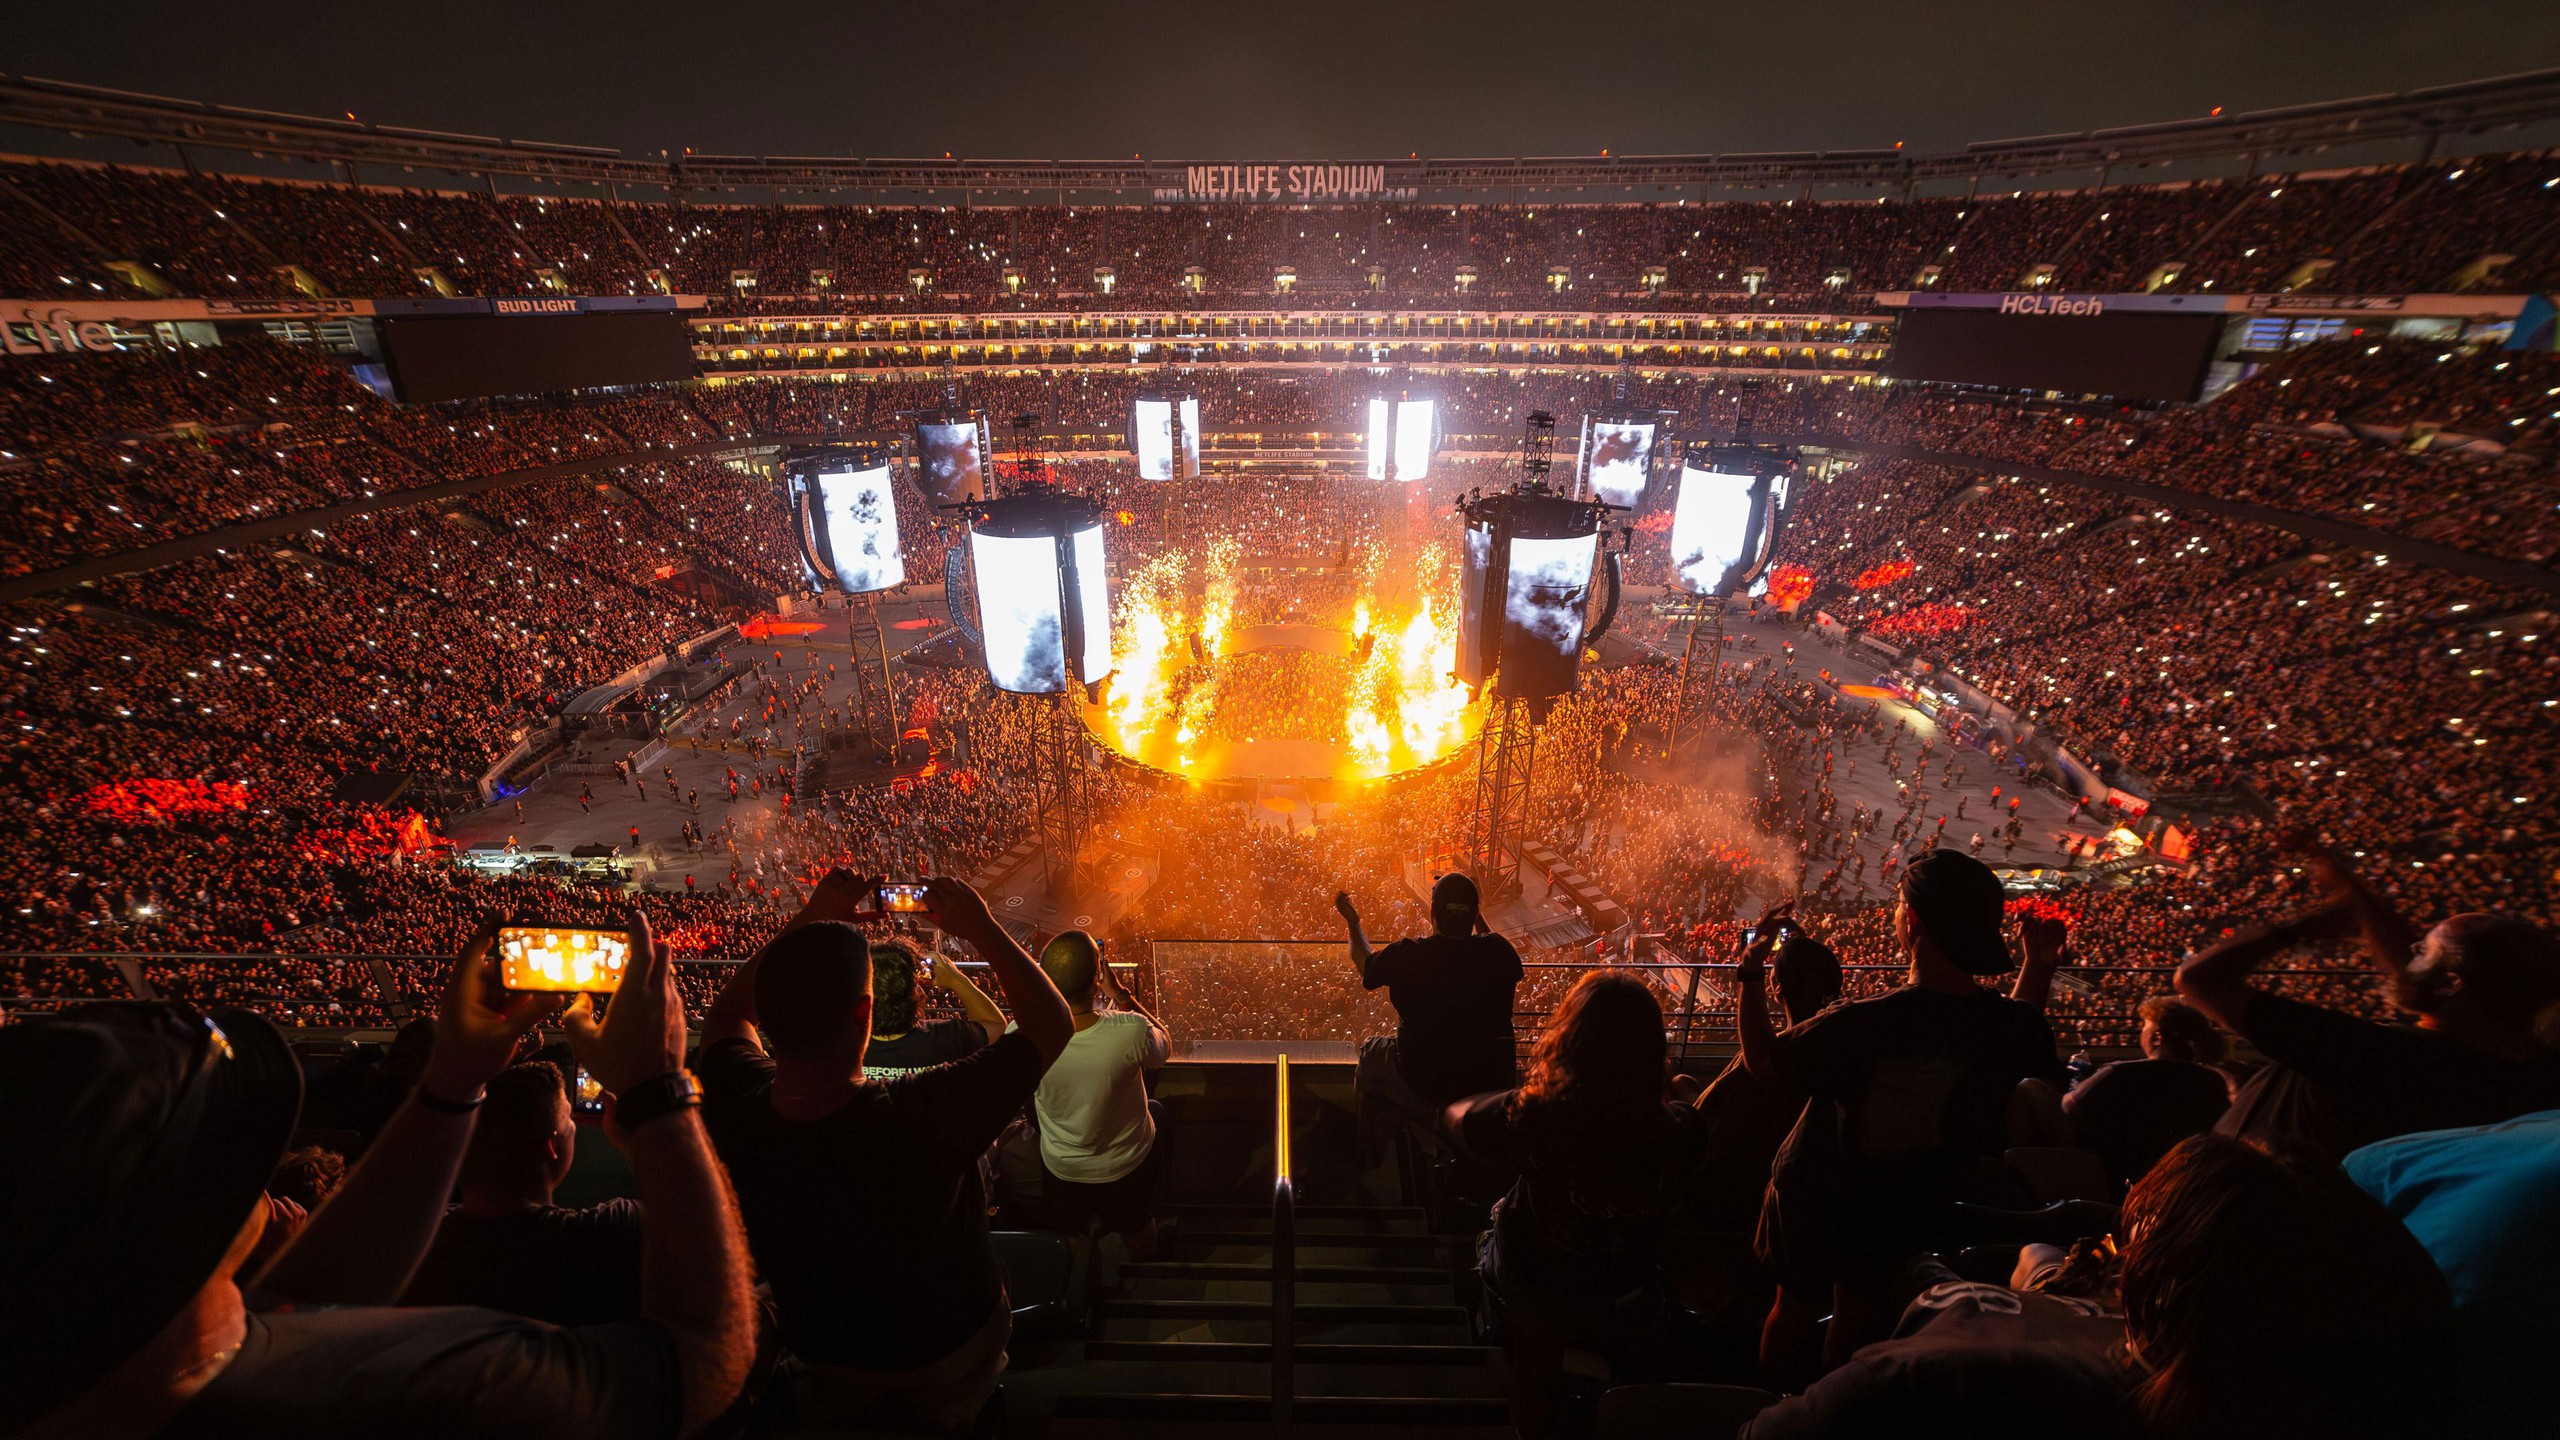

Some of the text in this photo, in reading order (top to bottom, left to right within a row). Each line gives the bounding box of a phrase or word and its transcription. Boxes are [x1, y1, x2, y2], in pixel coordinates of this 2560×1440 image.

[1187, 165, 1385, 193] METLIFE STADIUM
[496, 299, 577, 313] BUD LIGHT
[1999, 294, 2104, 316] HCLTech
[0, 308, 116, 356] Life
[861, 1066, 906, 1076] BEFORE
